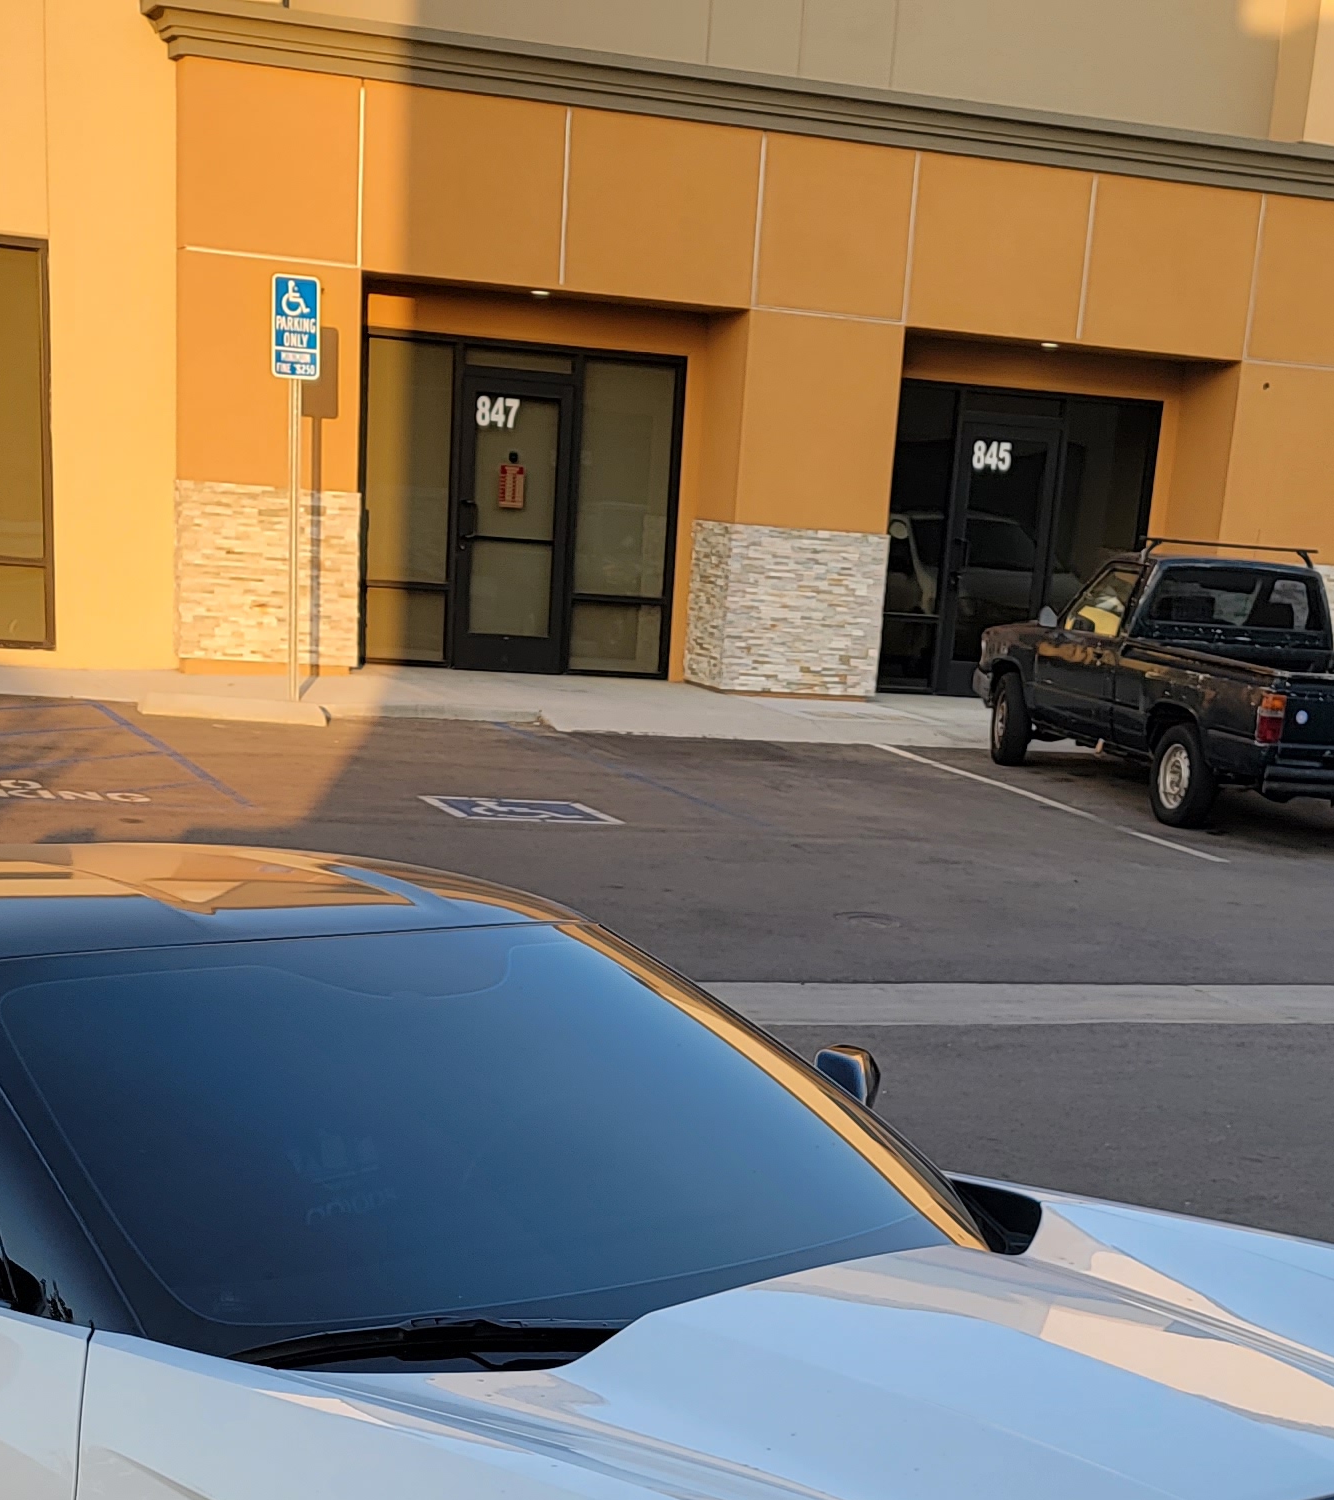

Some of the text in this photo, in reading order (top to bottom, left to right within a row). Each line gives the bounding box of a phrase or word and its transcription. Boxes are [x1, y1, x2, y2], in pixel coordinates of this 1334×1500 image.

[276, 315, 316, 334] PARKING
[283, 332, 309, 347] ONLY
[276, 362, 315, 375] FINE $250
[476, 395, 520, 428] 847
[972, 440, 1012, 471] 845
